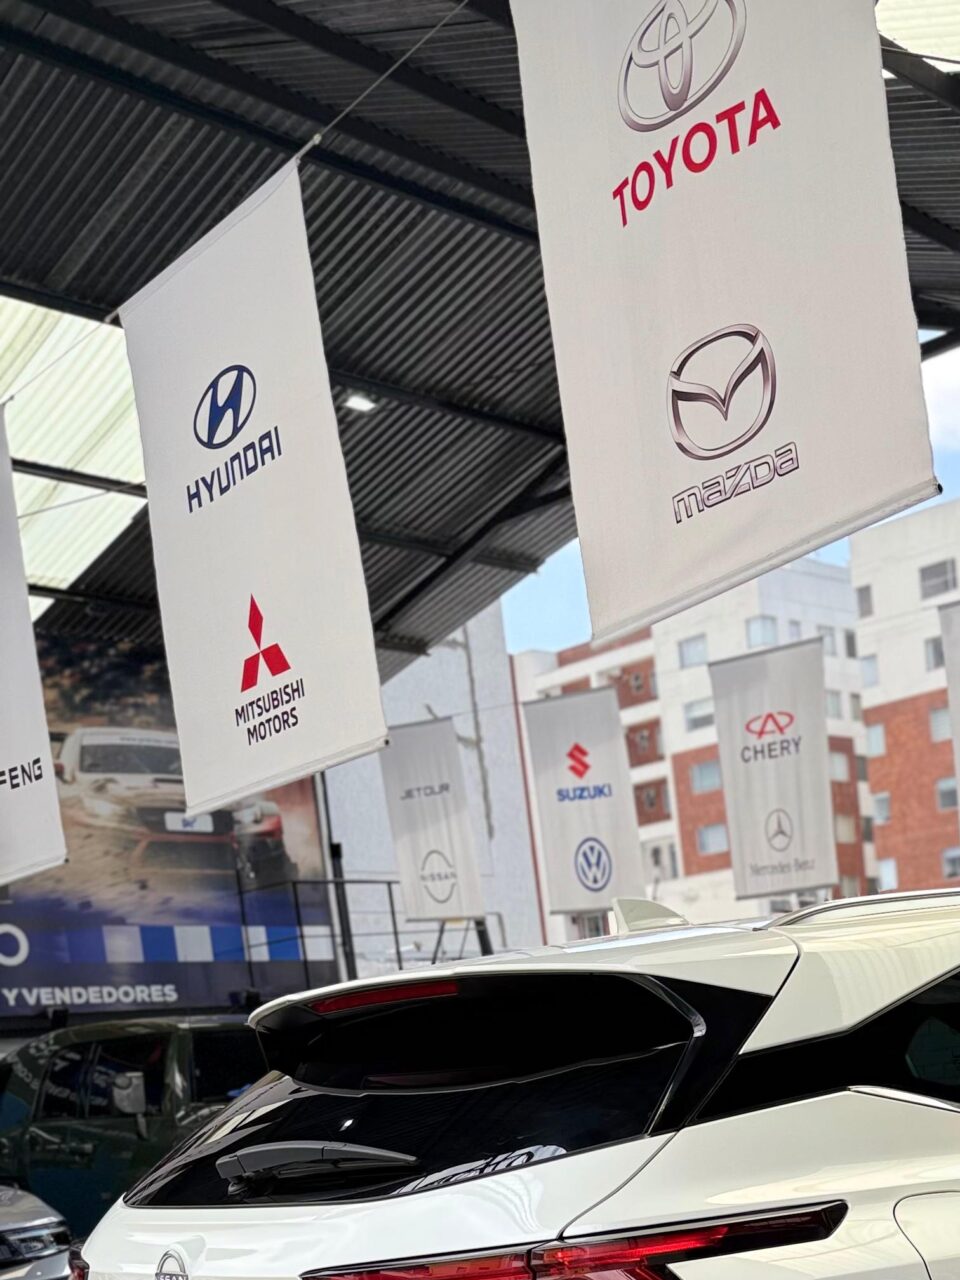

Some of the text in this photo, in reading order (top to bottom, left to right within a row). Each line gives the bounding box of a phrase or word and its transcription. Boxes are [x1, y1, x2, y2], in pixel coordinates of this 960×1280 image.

[612, 88, 781, 228] TOYOTA
[187, 426, 282, 513] HYUNDAI
[235, 678, 305, 727] MITSUBISHI
[247, 706, 299, 746] MOTORS
[740, 735, 802, 764] CHERY
[400, 783, 449, 800] JETOUR
[556, 783, 612, 802] SUZUKI
[2, 984, 178, 1007] Y VENDEDORES
